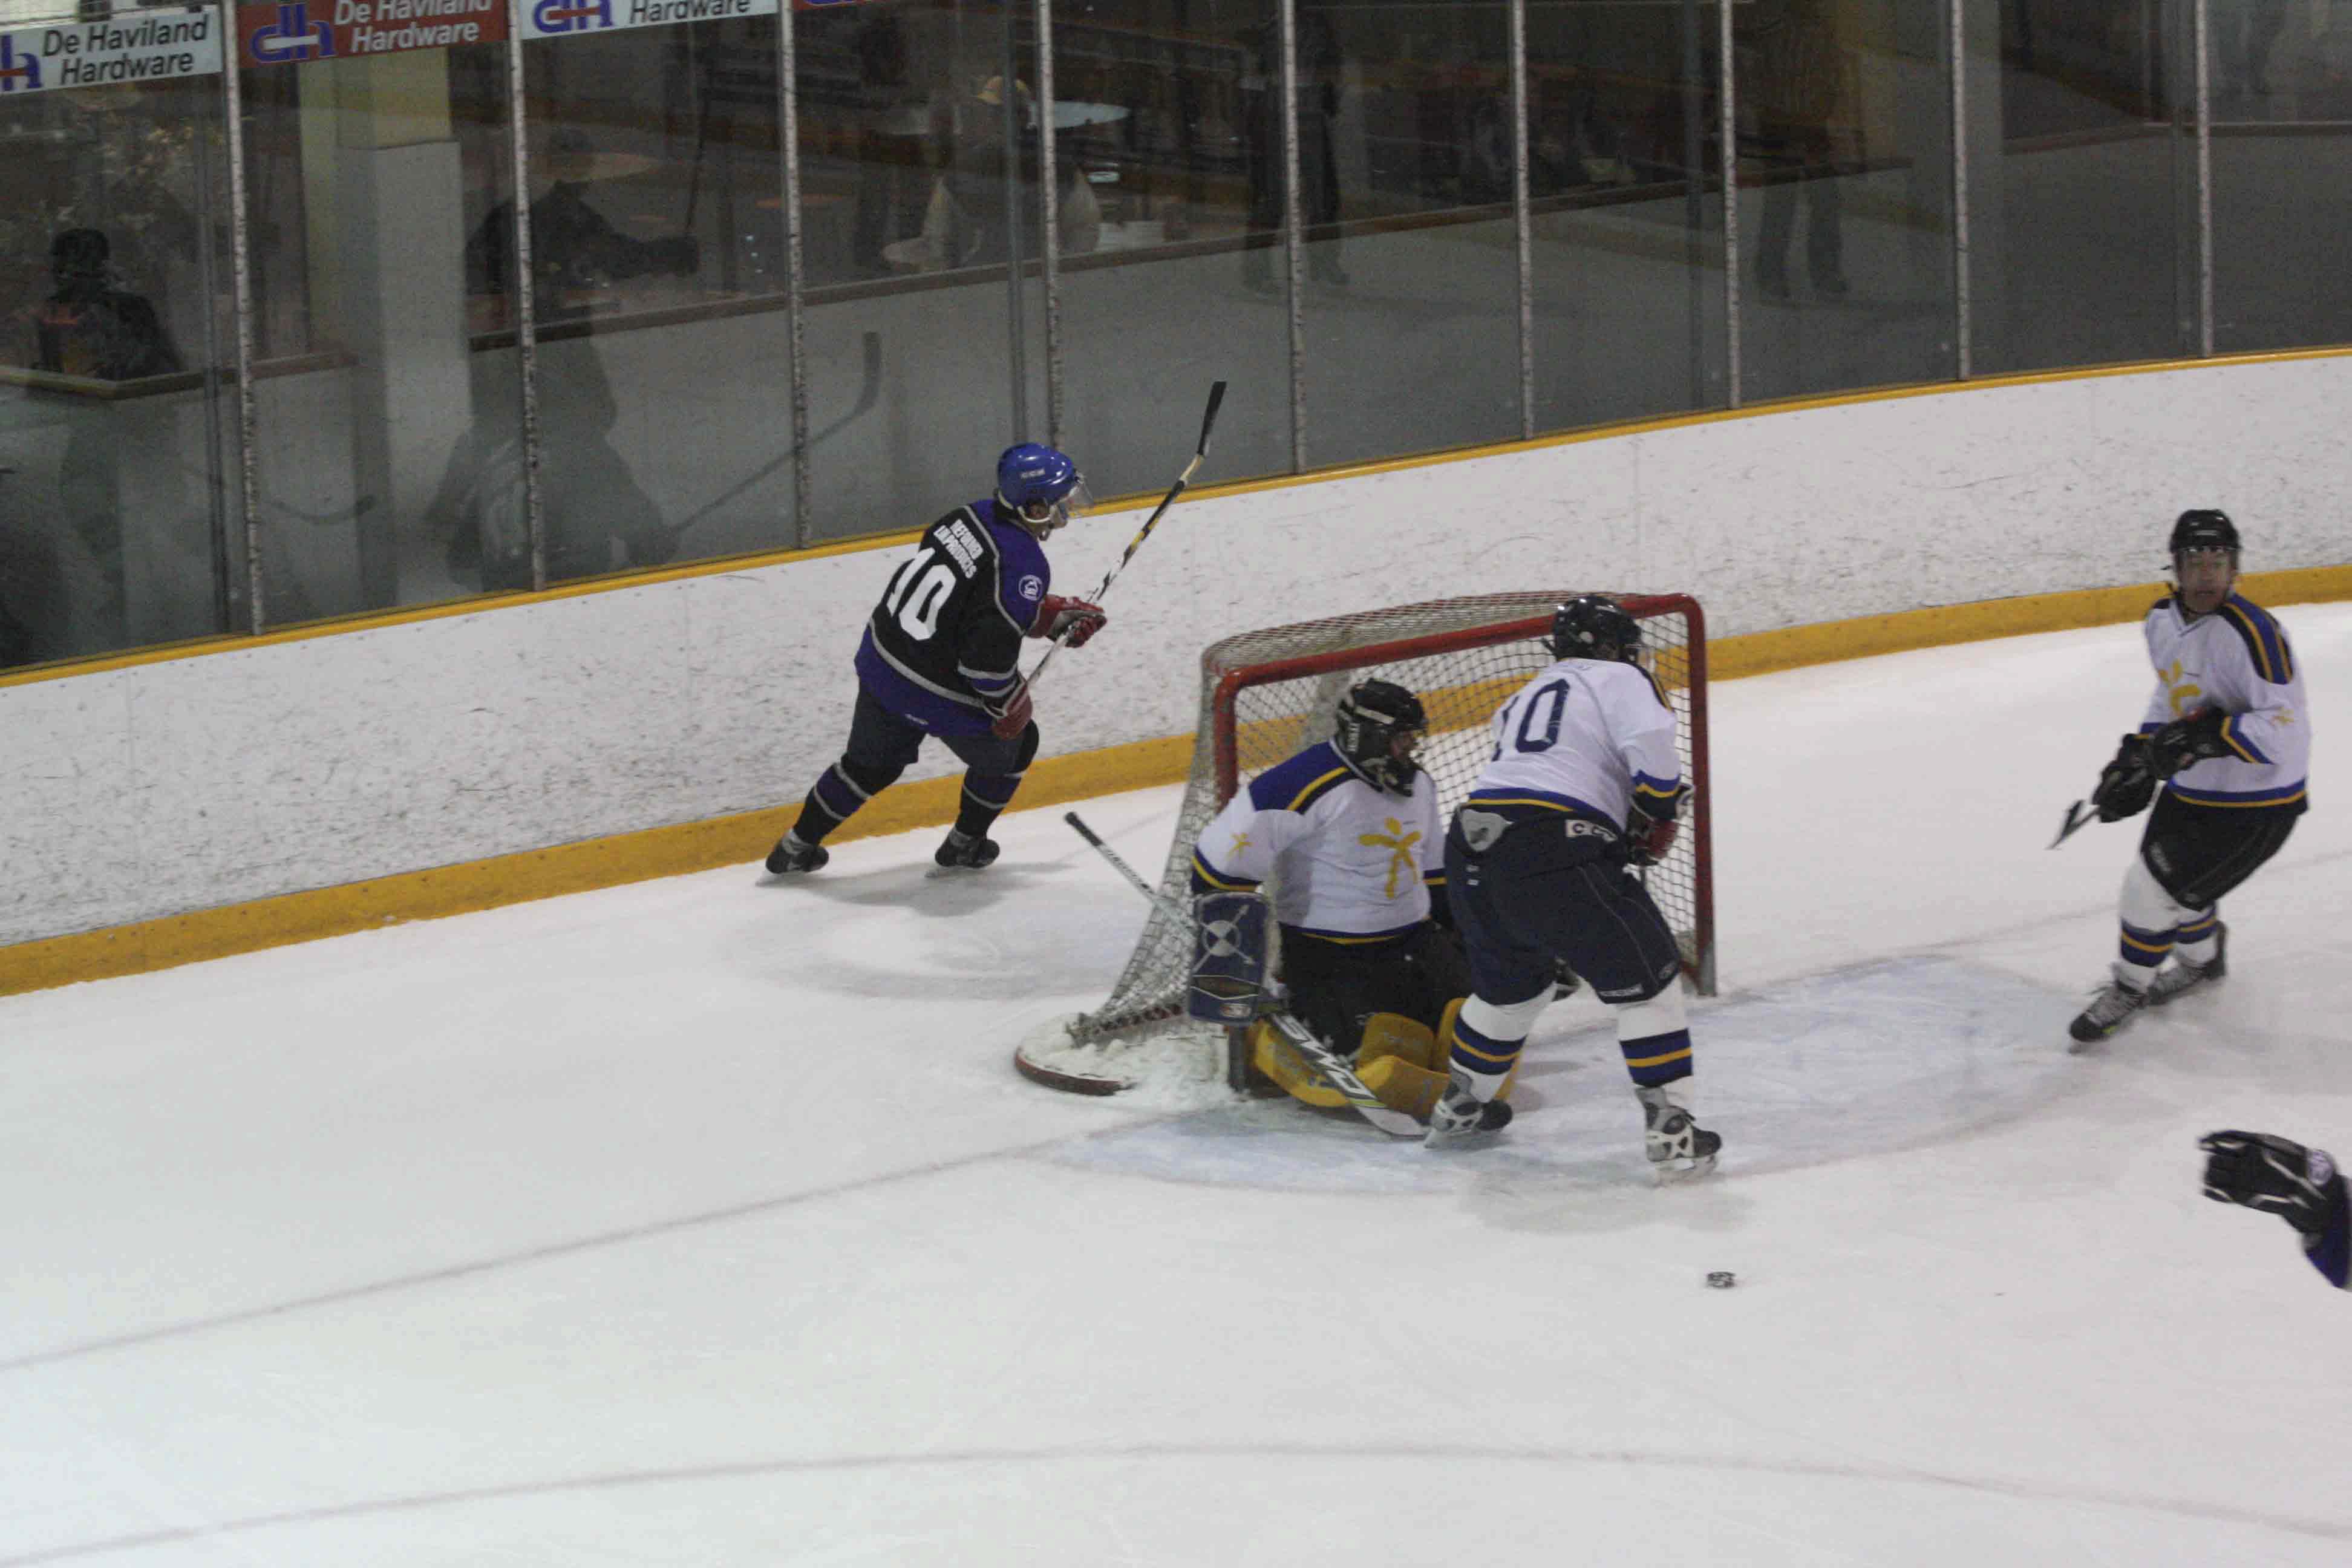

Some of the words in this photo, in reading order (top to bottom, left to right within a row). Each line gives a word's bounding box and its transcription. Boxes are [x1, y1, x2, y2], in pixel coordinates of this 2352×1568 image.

[335, 0, 371, 25] De
[629, 0, 751, 24] Hardware
[42, 30, 79, 57] De
[87, 14, 209, 52] Haviland
[351, 21, 480, 53] Hardware
[61, 52, 194, 85] Hardware
